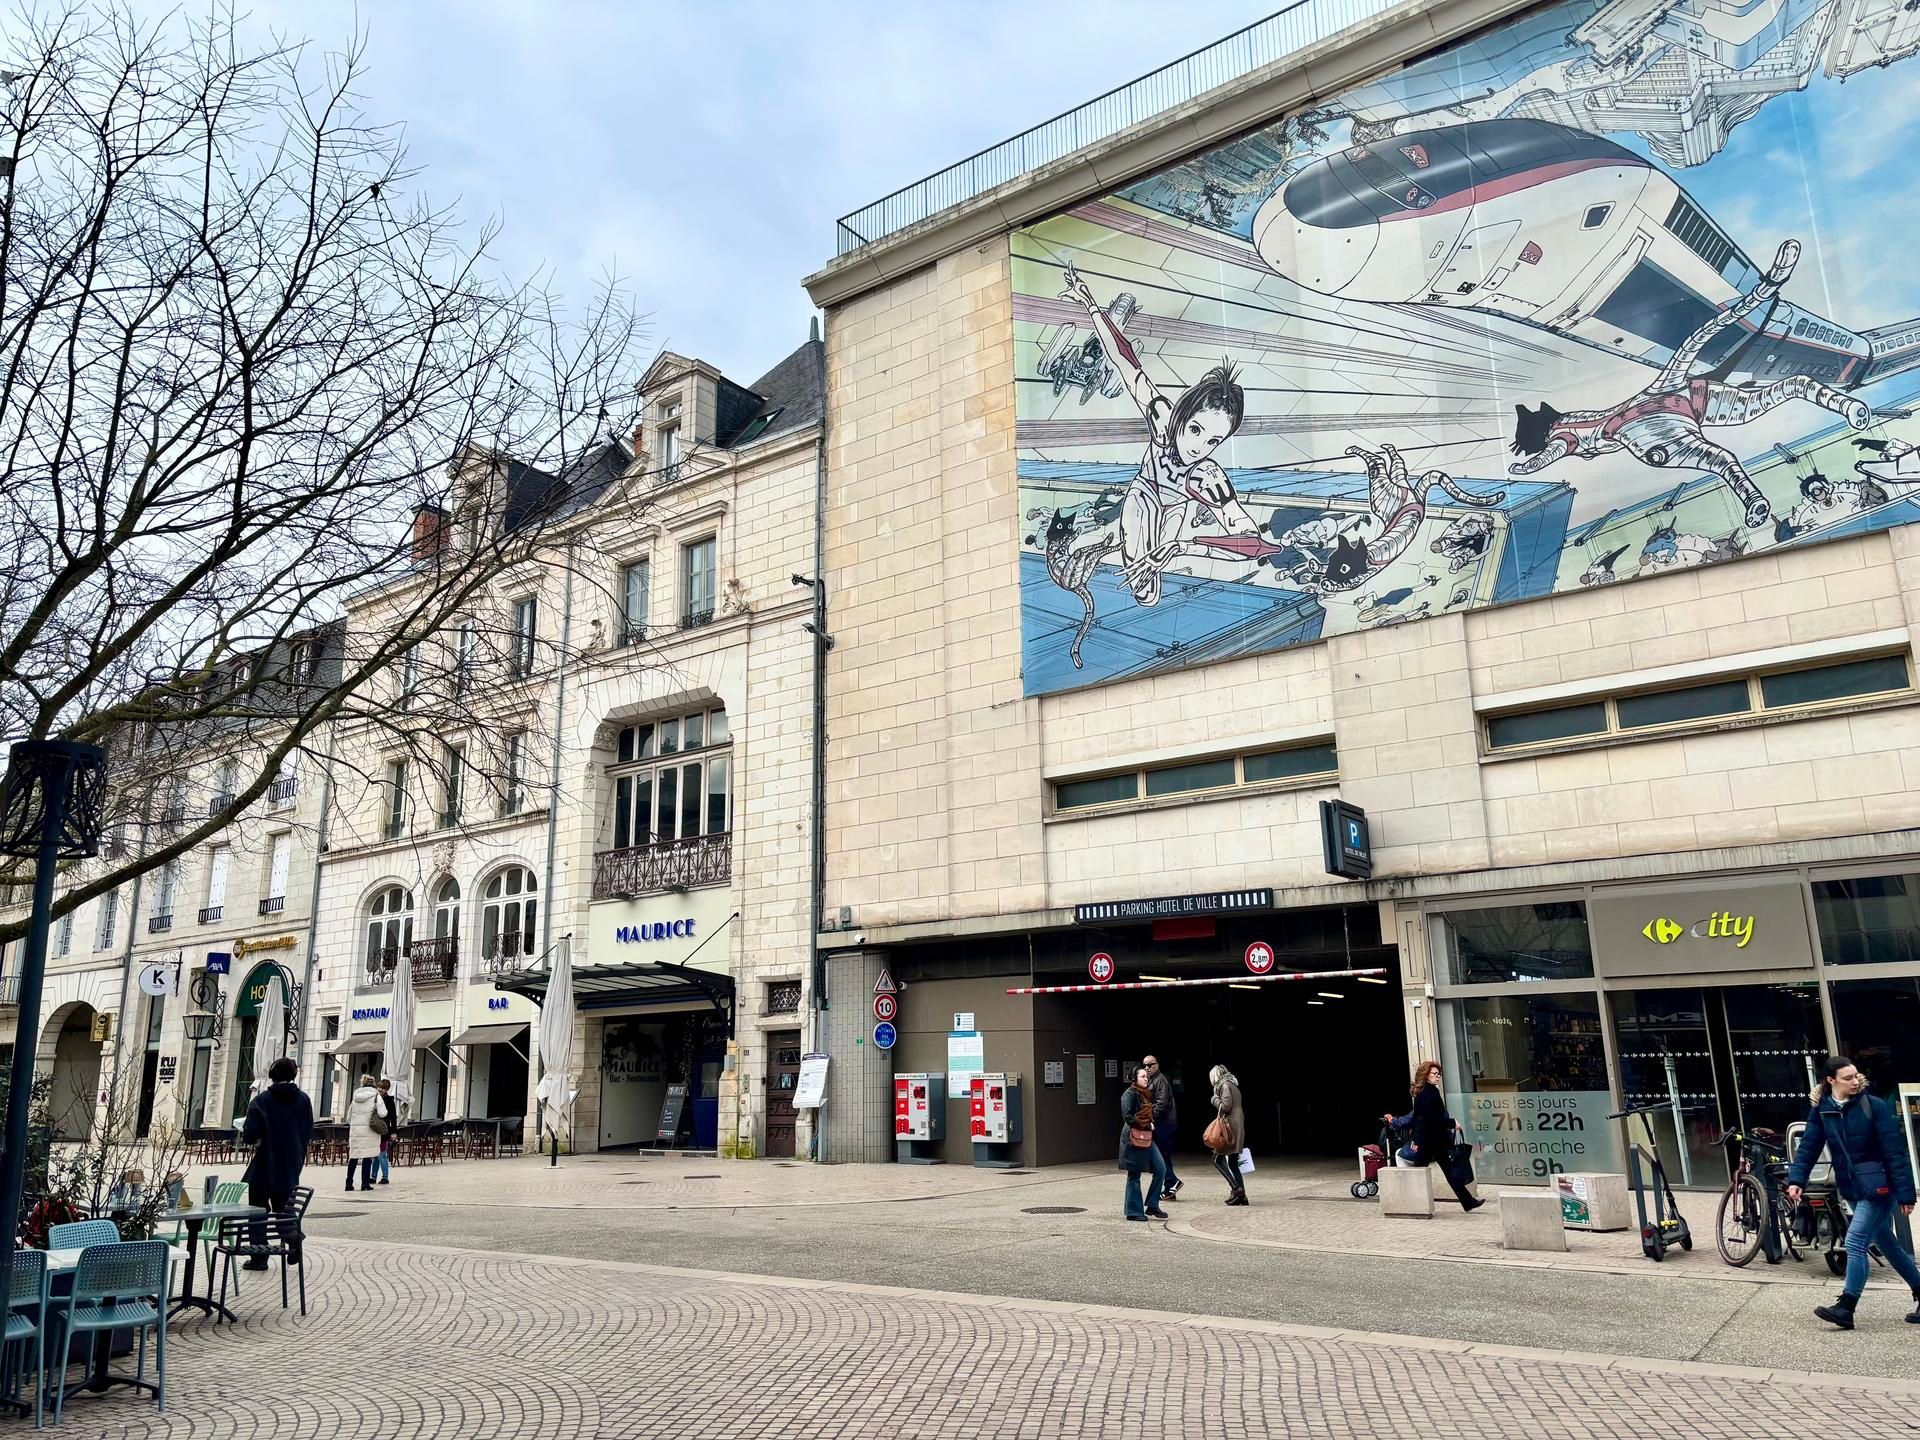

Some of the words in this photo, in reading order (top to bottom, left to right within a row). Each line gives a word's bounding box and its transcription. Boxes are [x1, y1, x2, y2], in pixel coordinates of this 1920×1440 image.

[1350, 823, 1358, 843] P
[1121, 902, 1154, 916] PARKING
[1156, 900, 1181, 913] HOTEL
[1183, 898, 1193, 911] DE
[1195, 895, 1218, 910] VILLE
[616, 918, 696, 944] MAURICE
[152, 969, 165, 985] K
[488, 997, 508, 1009] BAR
[880, 1002, 892, 1013] 10
[1477, 1098, 1509, 1109] tous
[1513, 1096, 1535, 1109] les
[1537, 1095, 1577, 1111] jours
[1475, 1120, 1489, 1131] de
[1491, 1111, 1522, 1131] 7h
[1526, 1120, 1534, 1131] à
[1537, 1111, 1584, 1131] 22h
[1494, 1138, 1585, 1154] dimanche
[1504, 1164, 1531, 1177] dès
[1532, 1157, 1564, 1177] 9h
